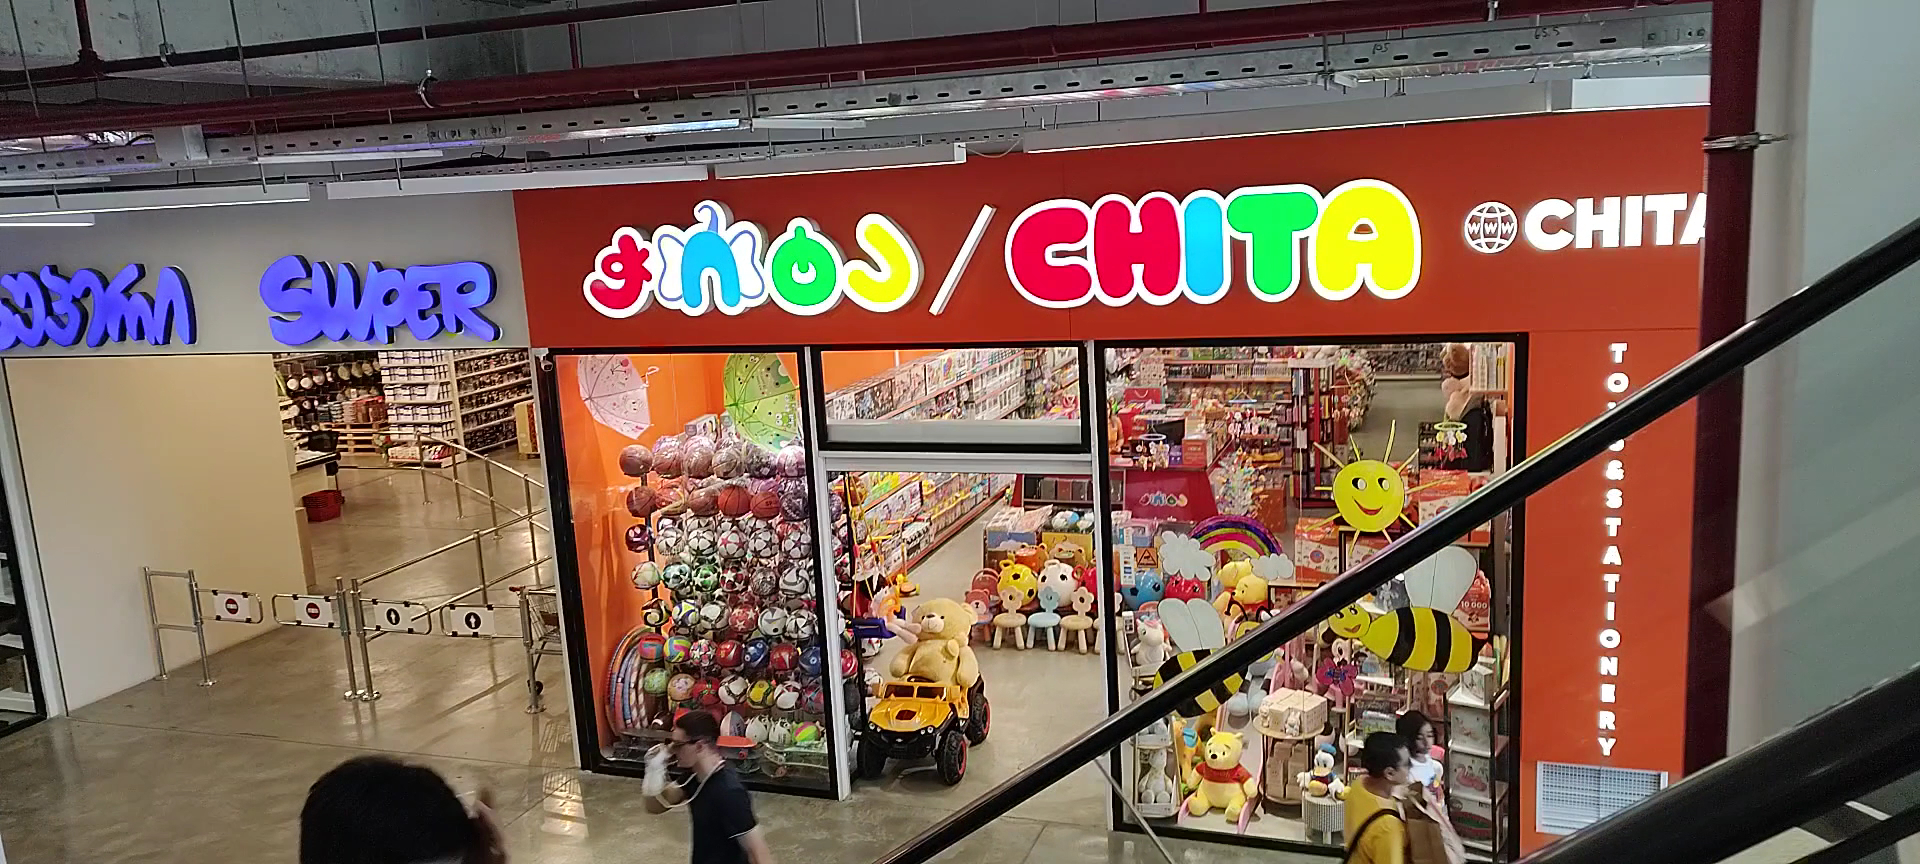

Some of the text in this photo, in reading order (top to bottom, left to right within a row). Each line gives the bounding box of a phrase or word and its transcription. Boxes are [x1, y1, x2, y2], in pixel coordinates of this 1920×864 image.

[260, 254, 503, 345] SUPER
[583, 199, 924, 319] ჭიტა
[1005, 178, 1422, 308] CHITA
